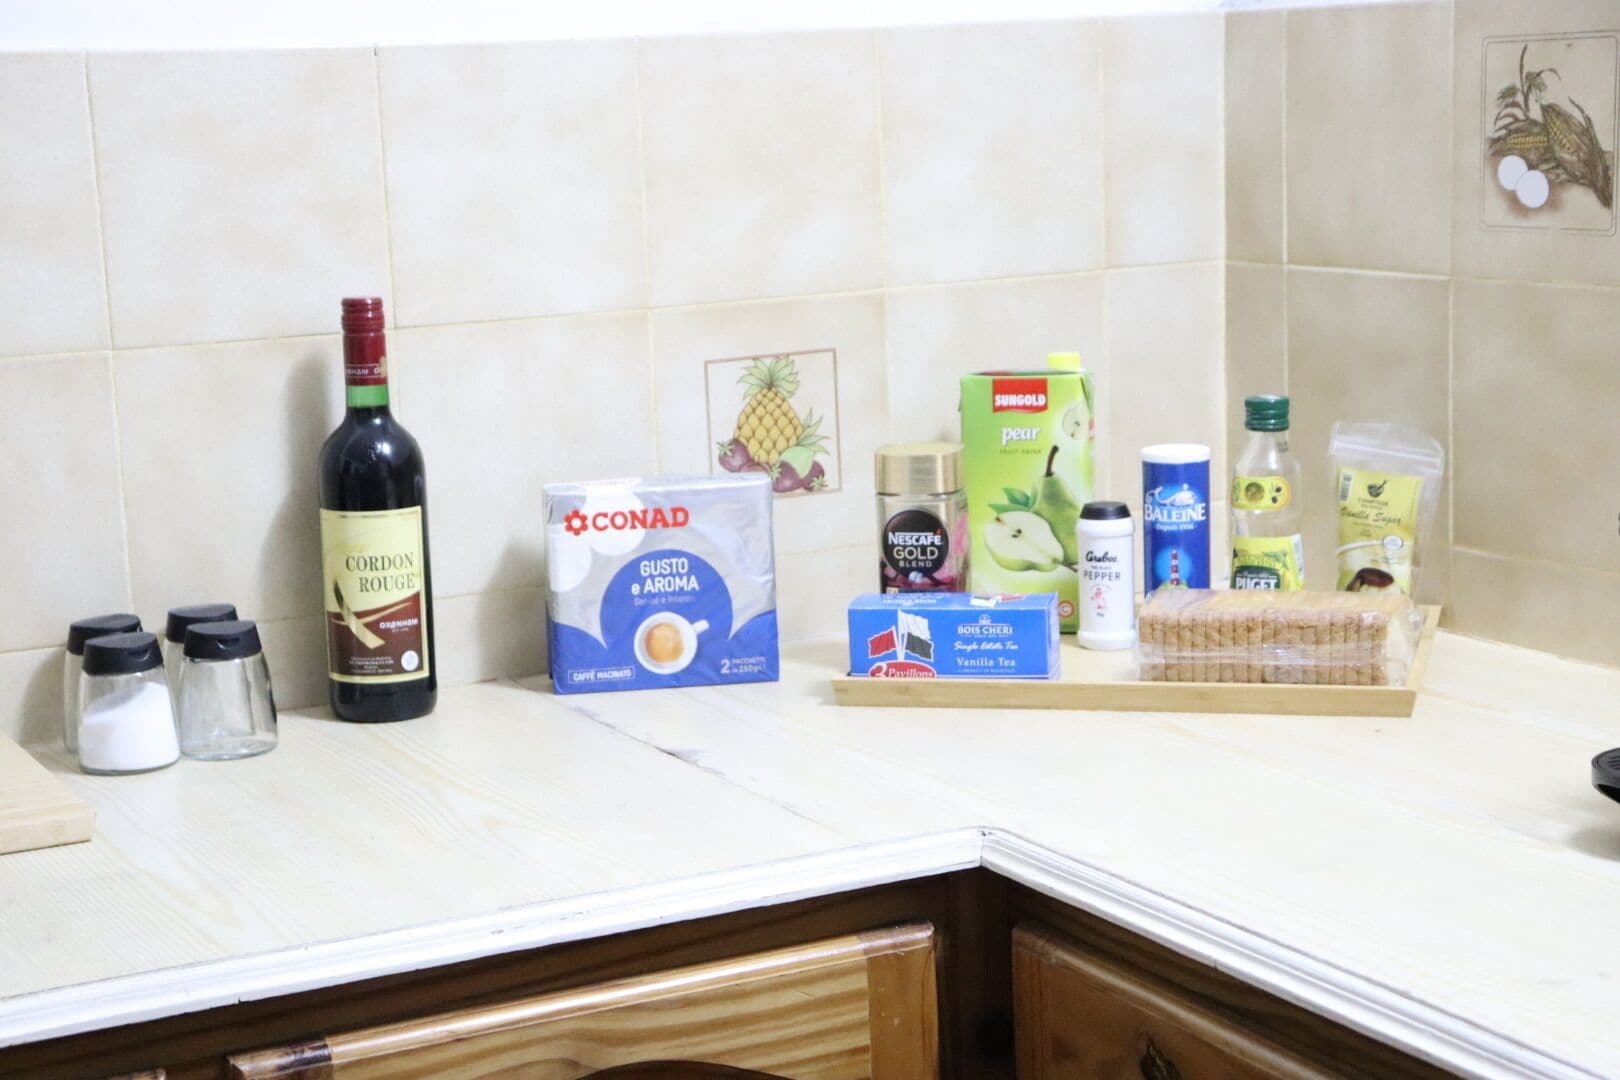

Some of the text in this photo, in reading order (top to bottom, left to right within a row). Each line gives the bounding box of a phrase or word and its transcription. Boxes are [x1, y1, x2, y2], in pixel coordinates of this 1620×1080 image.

[994, 394, 1046, 407] SUNGOLD
[1001, 427, 1041, 447] pear
[591, 506, 690, 532] CONAD
[1144, 503, 1207, 522] BALEINE
[893, 547, 939, 560] GOLD
[345, 553, 414, 572] CORDON
[640, 557, 688, 577] GUSTO
[359, 573, 416, 593] ROUGE
[1083, 570, 1121, 581] PEPPER
[631, 574, 700, 596] e AROMA
[957, 625, 981, 635] BOIS
[720, 659, 730, 674] 2
[956, 656, 1016, 667] Vanilla Tea
[888, 668, 934, 679] Pavillons
